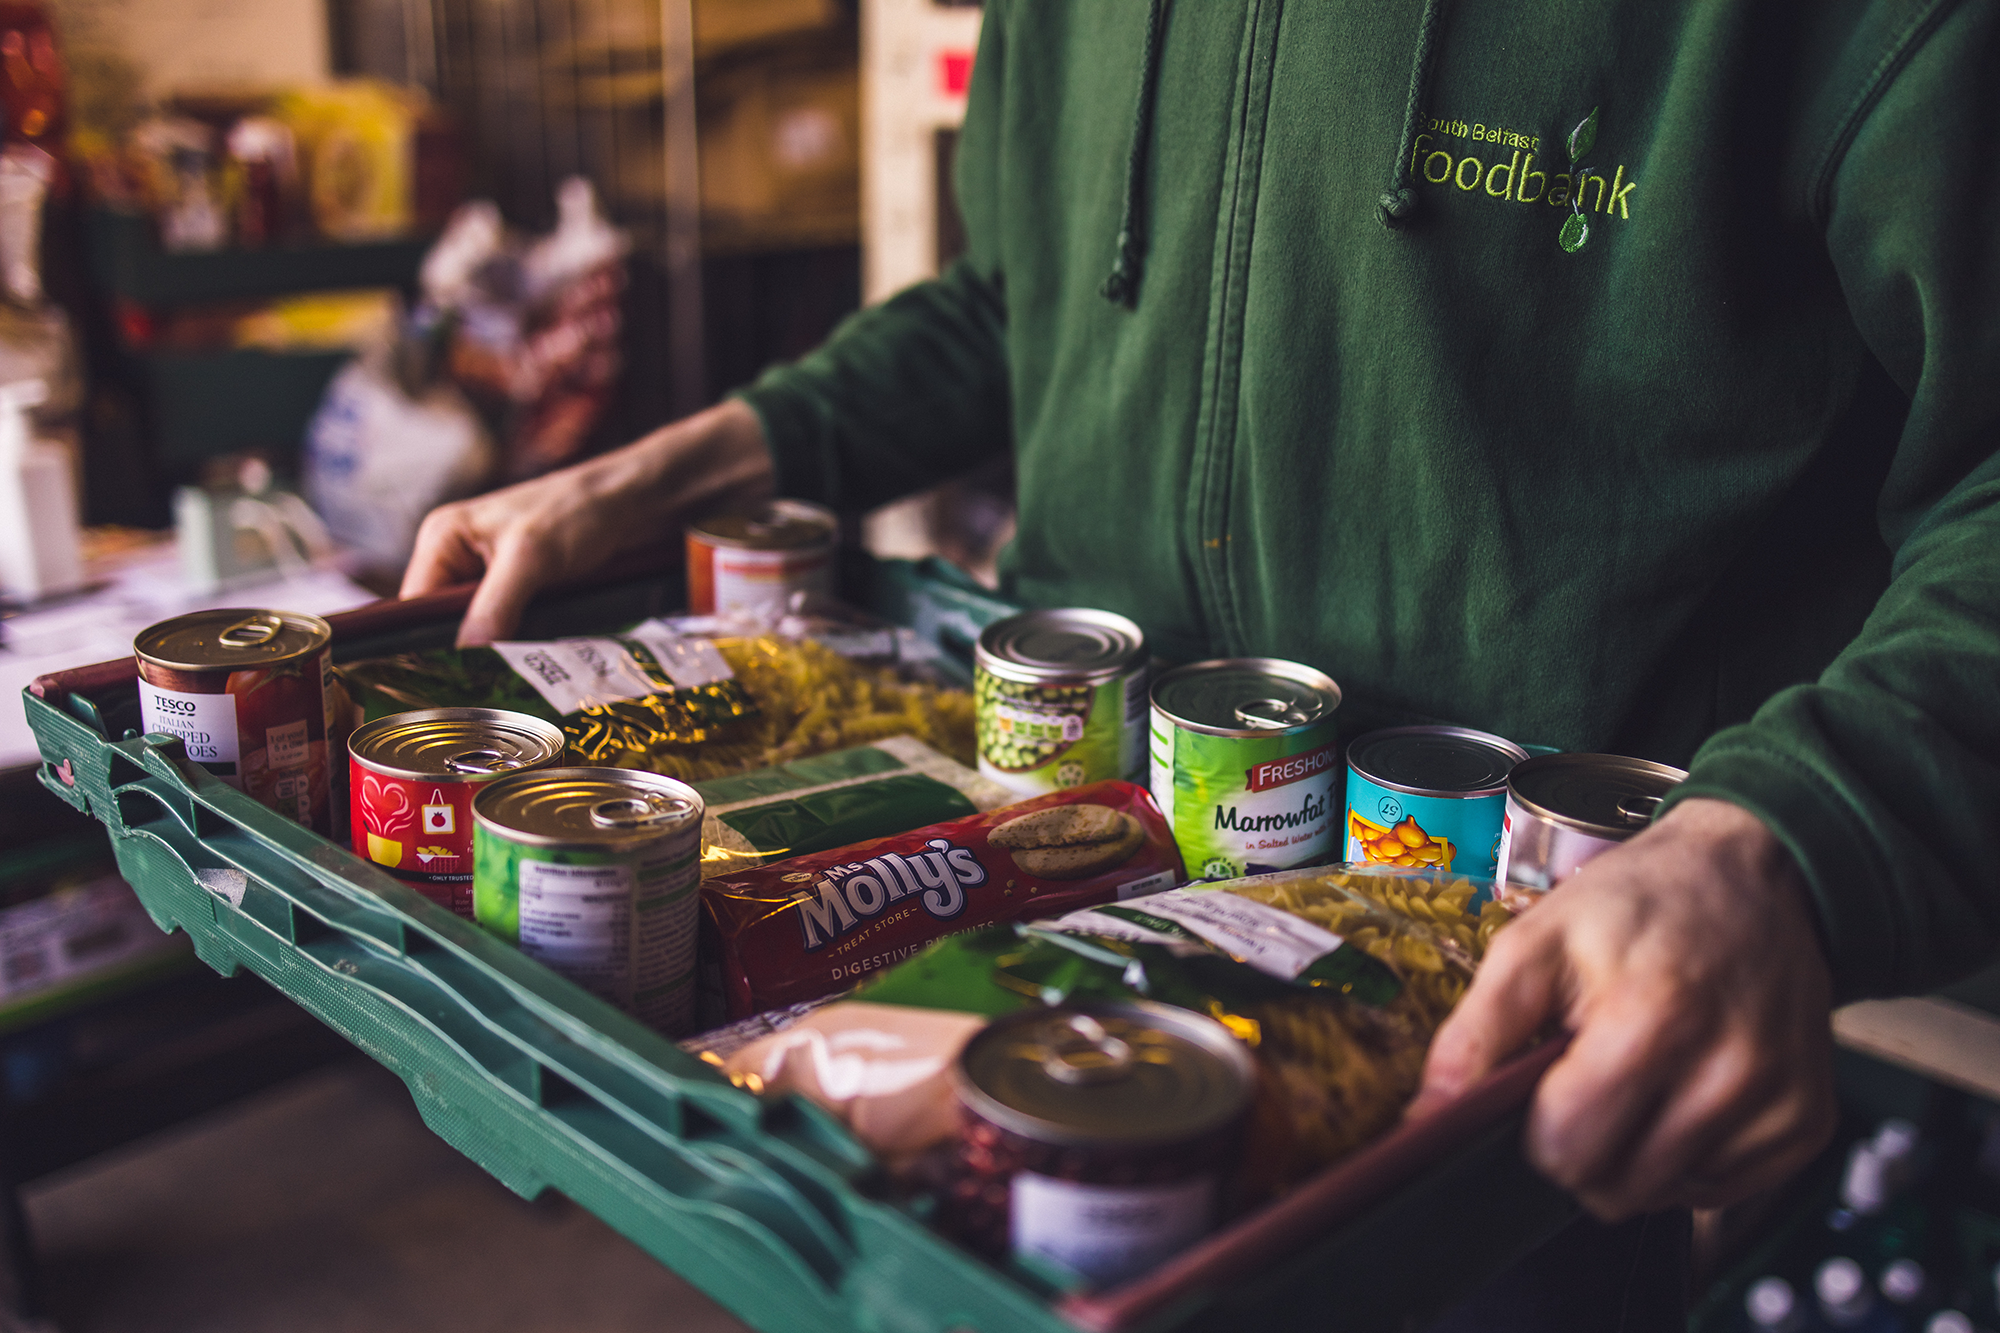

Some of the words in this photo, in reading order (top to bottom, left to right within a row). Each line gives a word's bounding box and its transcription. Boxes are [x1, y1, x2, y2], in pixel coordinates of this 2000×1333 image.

[1472, 124, 1539, 151] Belfast
[1410, 134, 1636, 219] foodbank
[154, 694, 196, 712] TESCO
[159, 715, 194, 730] ITALIAN
[188, 744, 218, 758] OES
[1259, 748, 1336, 786] FRESHON
[1215, 793, 1325, 832] Marrowfat
[1382, 803, 1398, 816] 57
[1245, 842, 1255, 850] in
[1258, 837, 1289, 850] Salted
[1291, 832, 1313, 844] Water
[822, 861, 864, 881] Ms
[789, 838, 986, 950] Molly's
[836, 928, 870, 955] TREAT
[874, 908, 911, 932] STORE
[831, 943, 918, 980] DIGESTIVE
